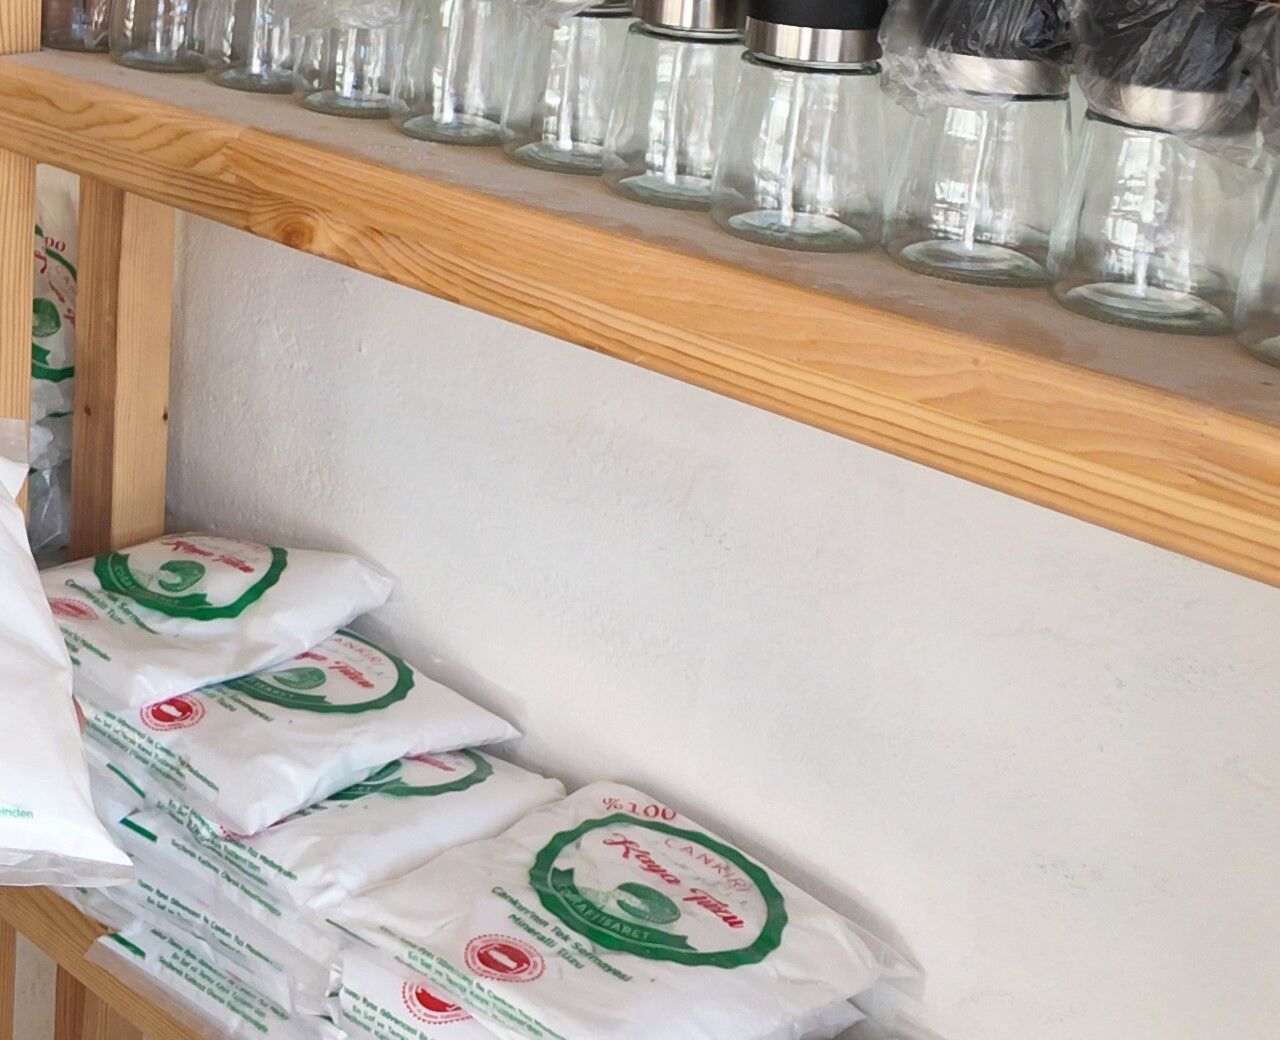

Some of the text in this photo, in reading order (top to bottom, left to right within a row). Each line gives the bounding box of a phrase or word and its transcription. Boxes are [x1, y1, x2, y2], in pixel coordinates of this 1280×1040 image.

[602, 797, 678, 821] %100
[603, 833, 744, 929] Kaya Tuzu
[508, 913, 556, 949] Mineralli
[557, 947, 584, 970] Tuzu
[551, 925, 571, 942] Tek
[571, 942, 633, 982] Sermayesi
